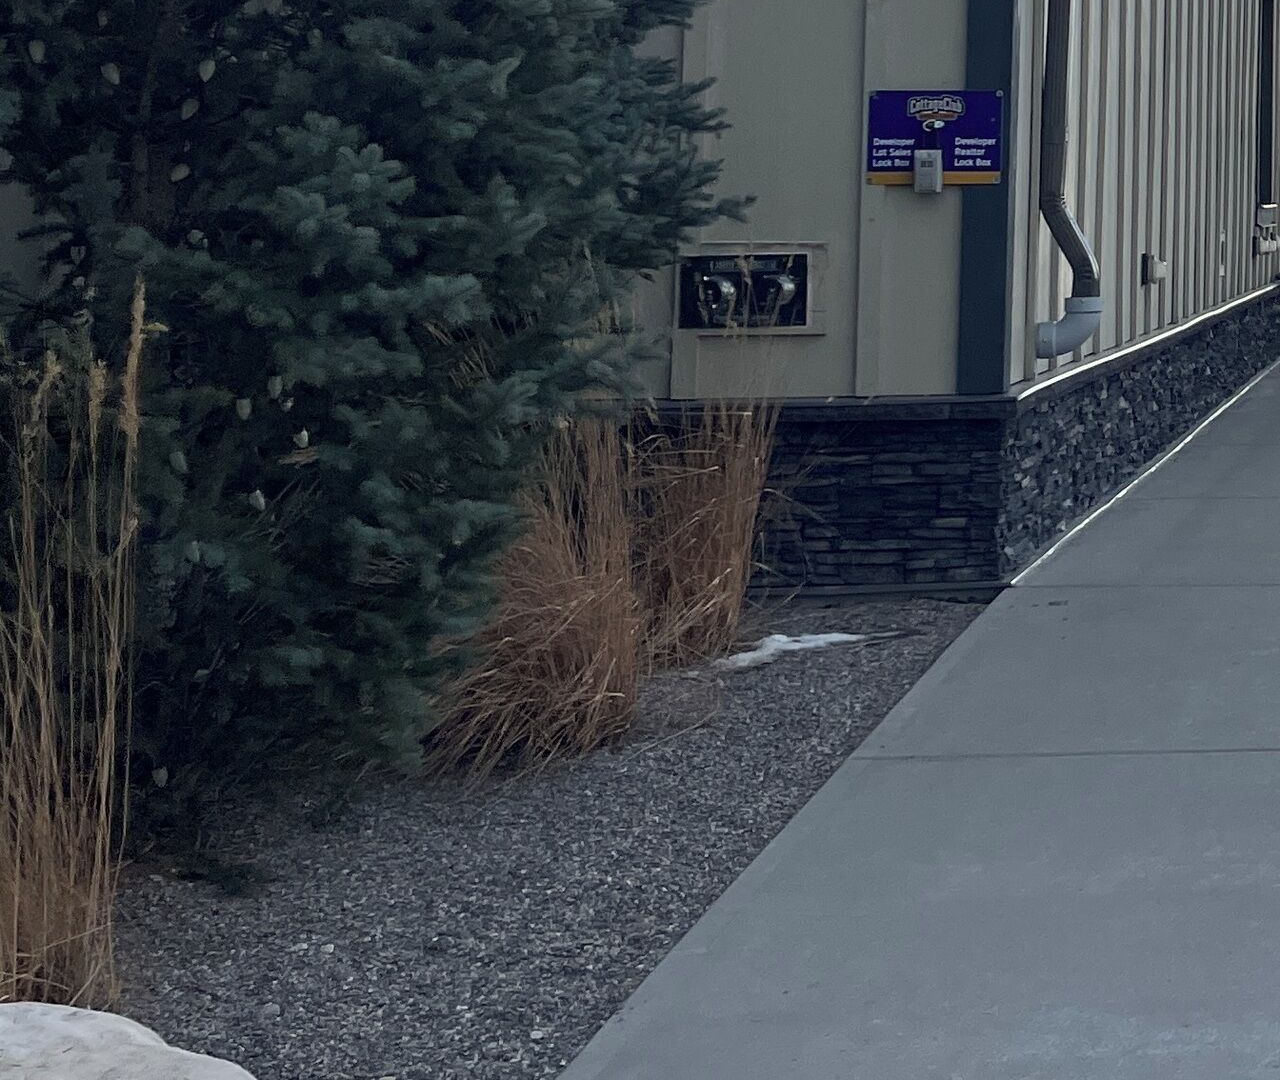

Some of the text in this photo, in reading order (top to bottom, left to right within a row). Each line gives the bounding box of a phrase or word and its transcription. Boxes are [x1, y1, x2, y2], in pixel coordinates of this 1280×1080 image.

[873, 138, 915, 147] Developer
[954, 137, 997, 146] Developer
[889, 148, 912, 156] Sales
[954, 147, 986, 156] Realtor
[873, 159, 910, 167] Lock Box
[954, 158, 992, 166] Lock Box
